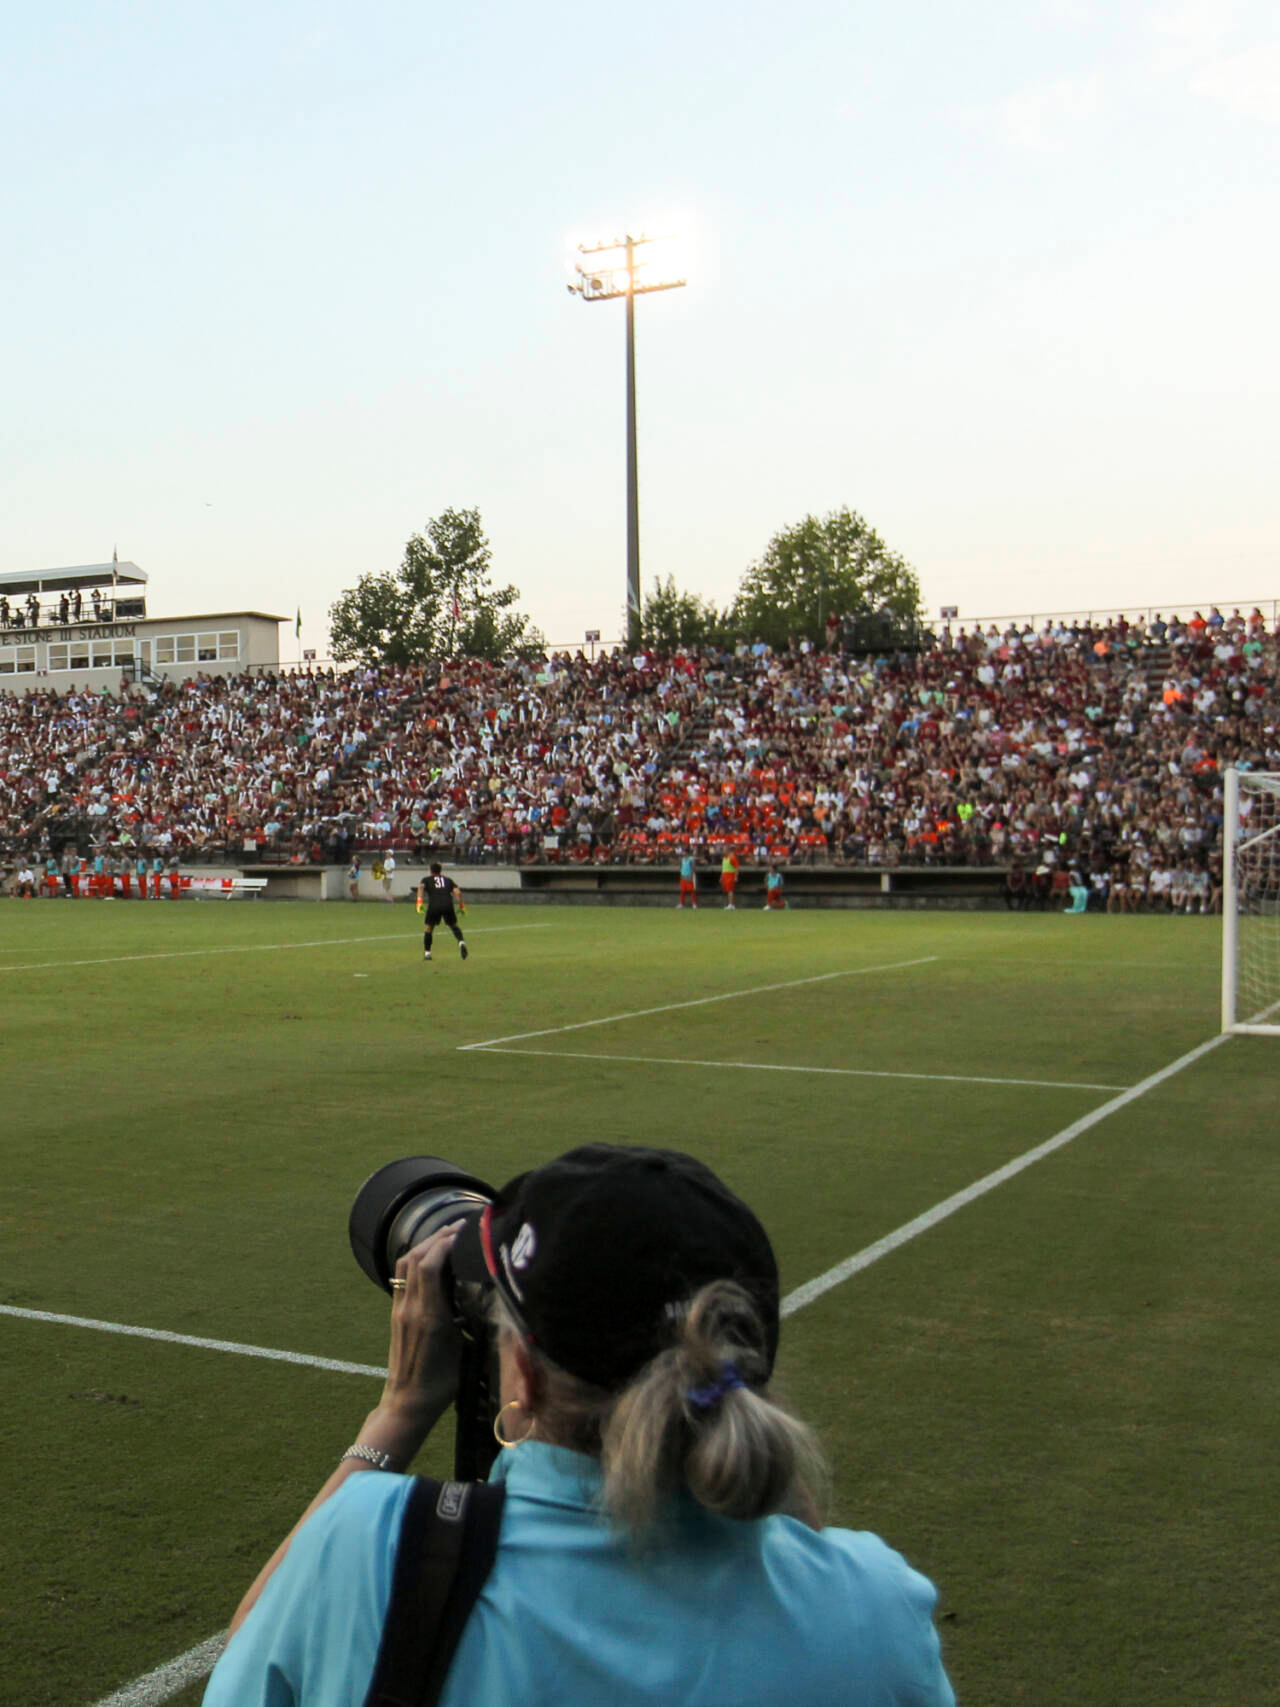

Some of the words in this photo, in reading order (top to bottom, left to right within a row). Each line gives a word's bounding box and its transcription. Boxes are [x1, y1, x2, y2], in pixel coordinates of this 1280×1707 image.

[15, 632, 52, 645] STONE
[60, 628, 72, 641] III
[79, 625, 136, 640] STADIUM
[434, 876, 445, 888] 31
